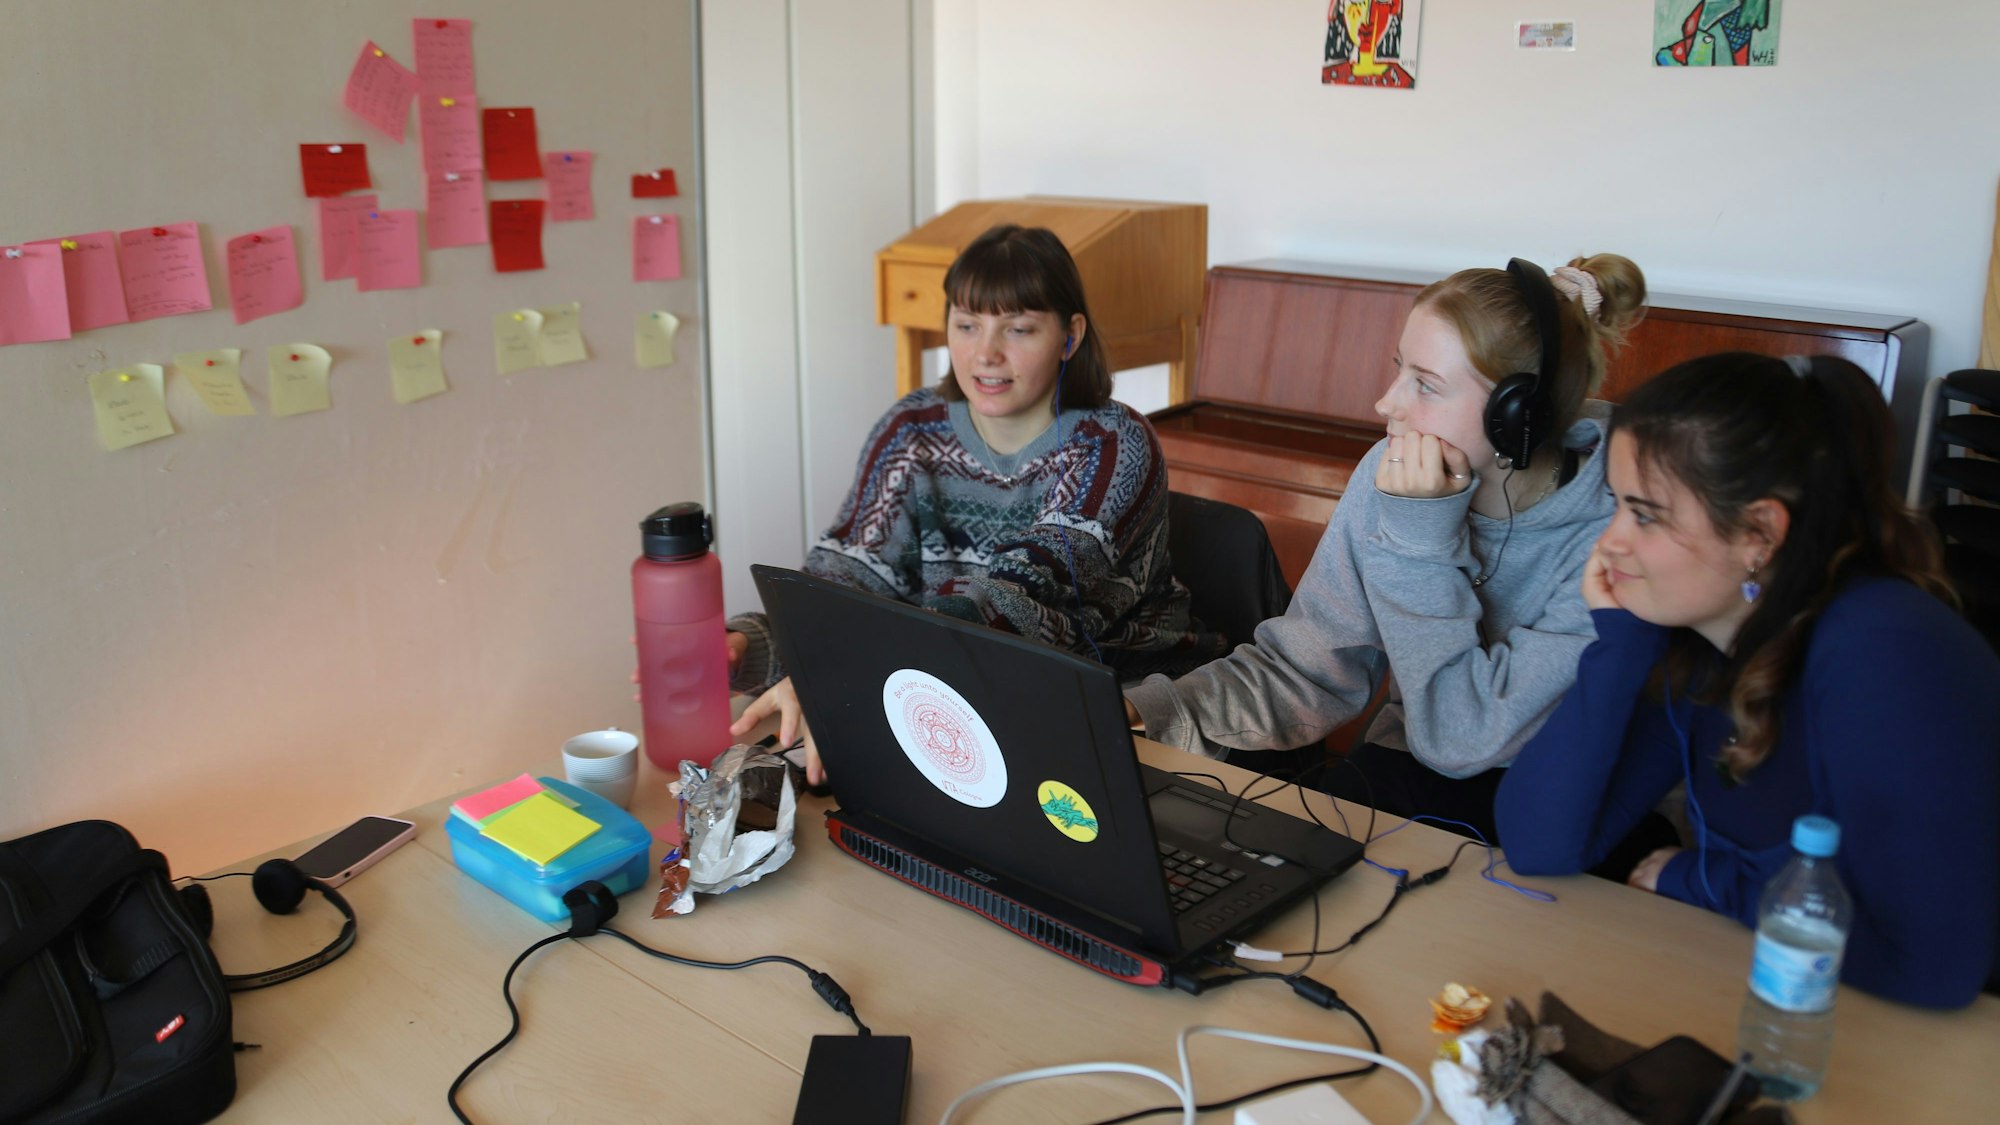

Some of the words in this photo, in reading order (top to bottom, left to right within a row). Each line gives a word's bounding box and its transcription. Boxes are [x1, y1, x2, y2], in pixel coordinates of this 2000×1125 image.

[902, 680, 920, 691] light
[920, 684, 938, 693] unto
[940, 691, 974, 722] yourself
